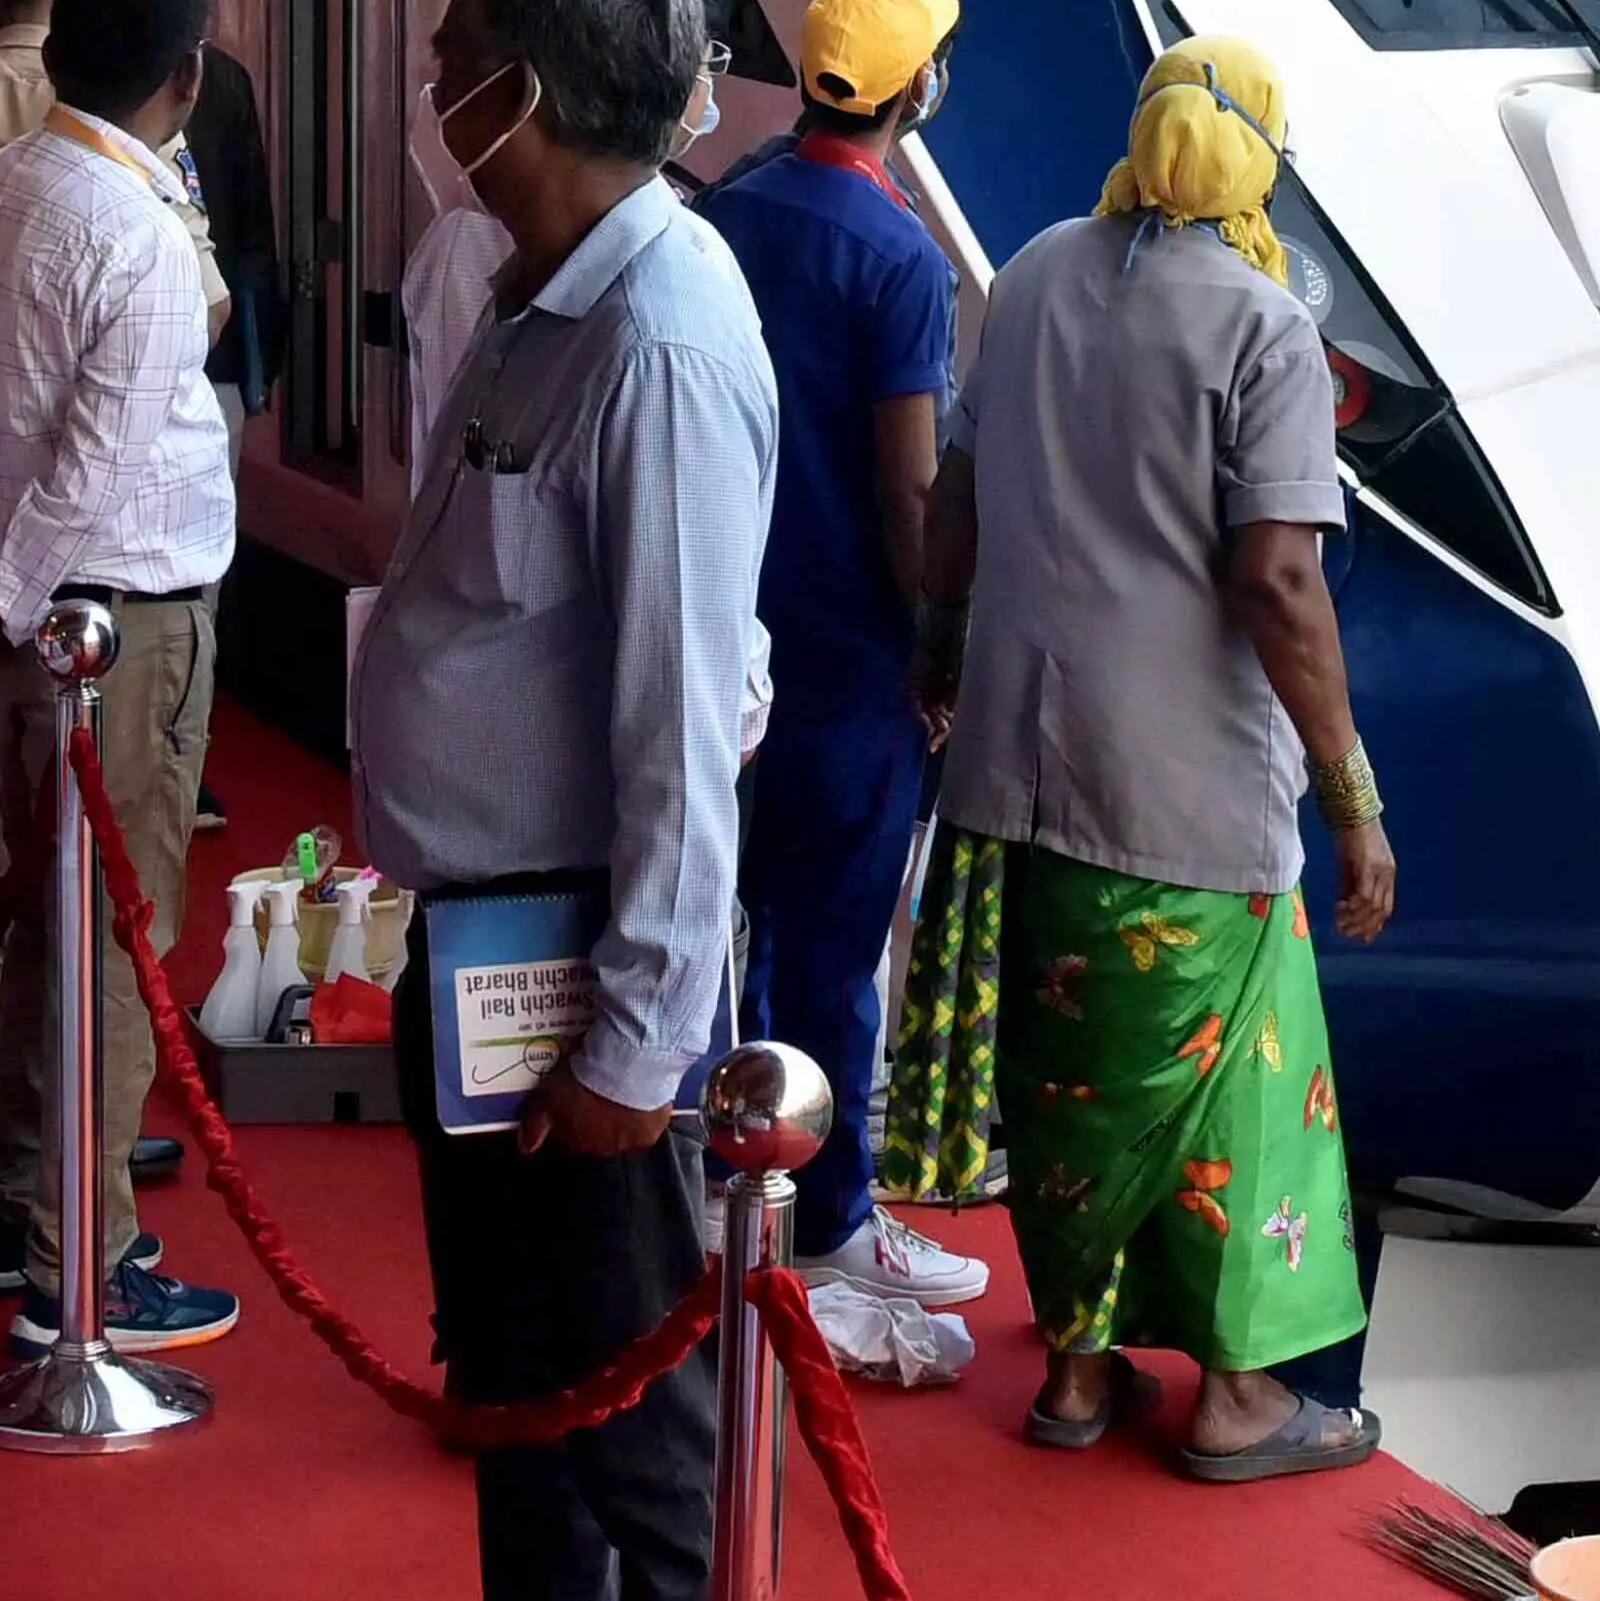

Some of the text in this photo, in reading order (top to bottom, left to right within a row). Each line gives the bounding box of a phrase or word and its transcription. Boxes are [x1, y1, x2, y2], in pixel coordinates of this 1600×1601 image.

[465, 967, 600, 995] wachh Bharat
[481, 989, 595, 1020] Swachh Rail
